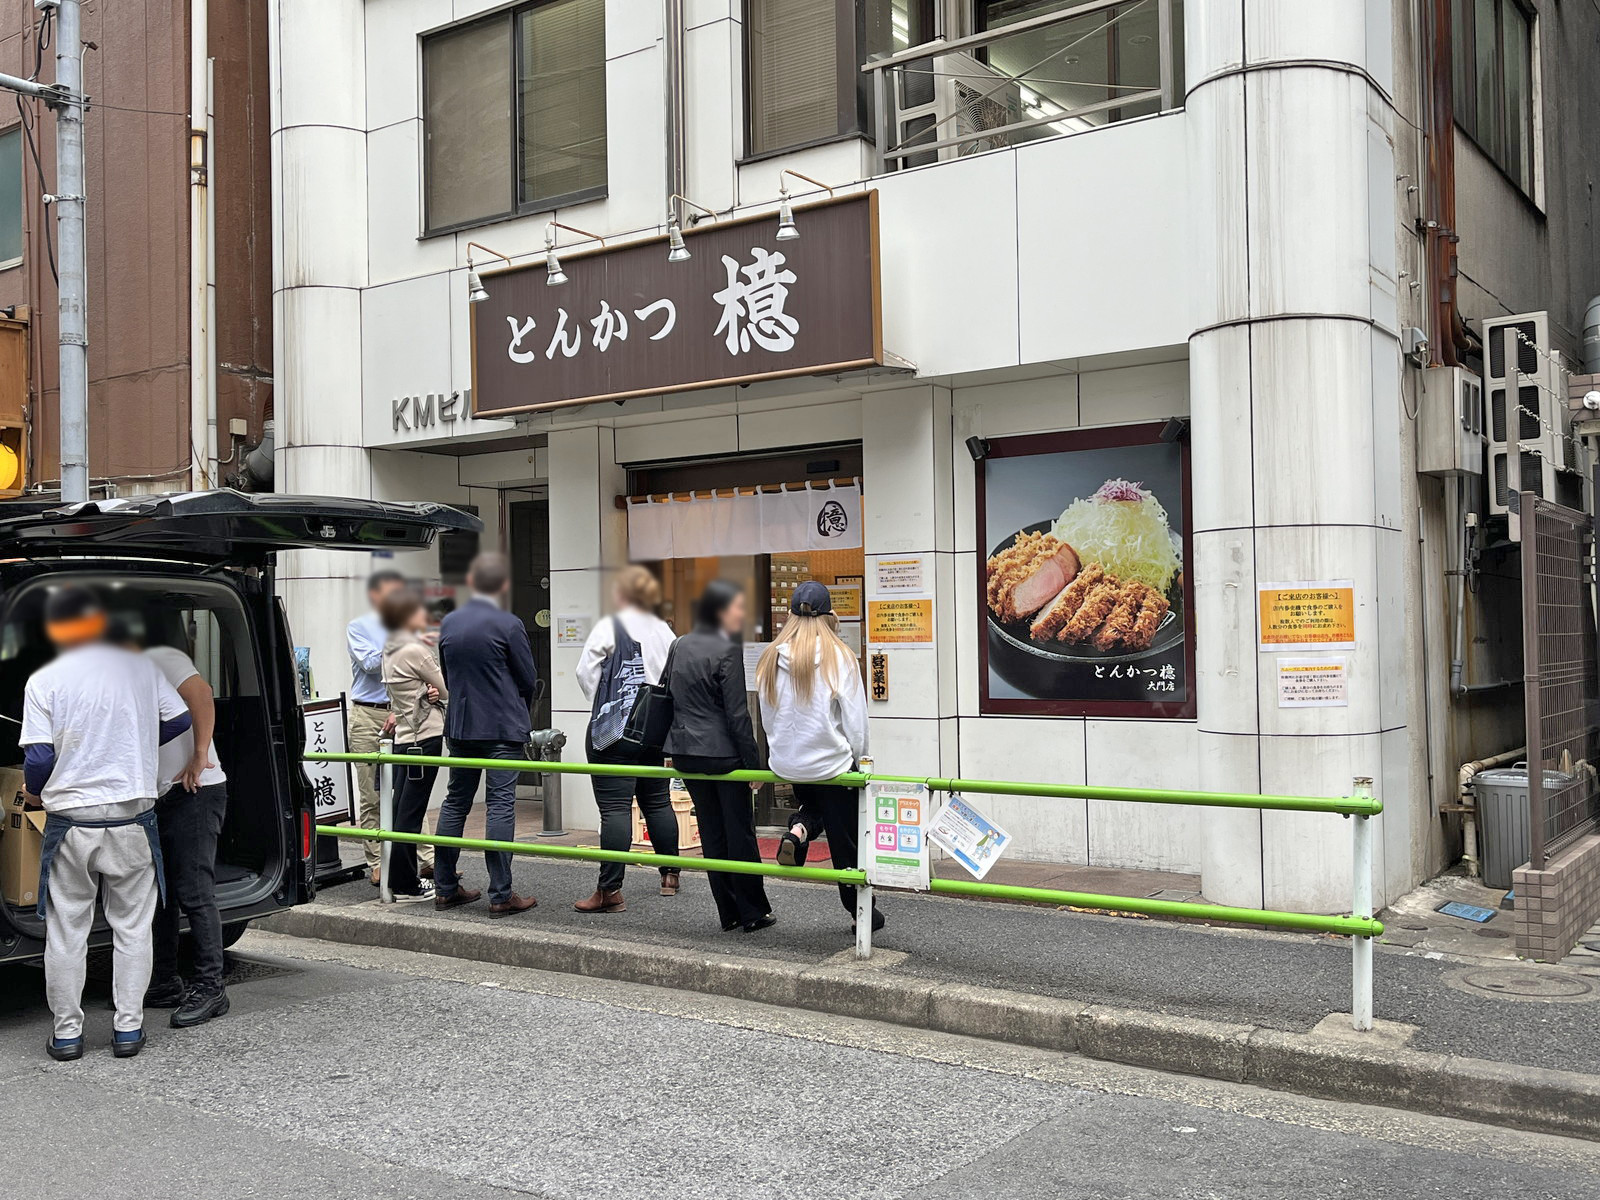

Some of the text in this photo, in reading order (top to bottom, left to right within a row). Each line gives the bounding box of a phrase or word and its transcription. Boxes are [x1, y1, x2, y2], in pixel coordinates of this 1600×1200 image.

[506, 298, 676, 364] とんかつ
[1277, 592, 1339, 601] 【ご来店のお客様へ】
[871, 655, 886, 698] 営業中
[1146, 680, 1175, 691] 大門店
